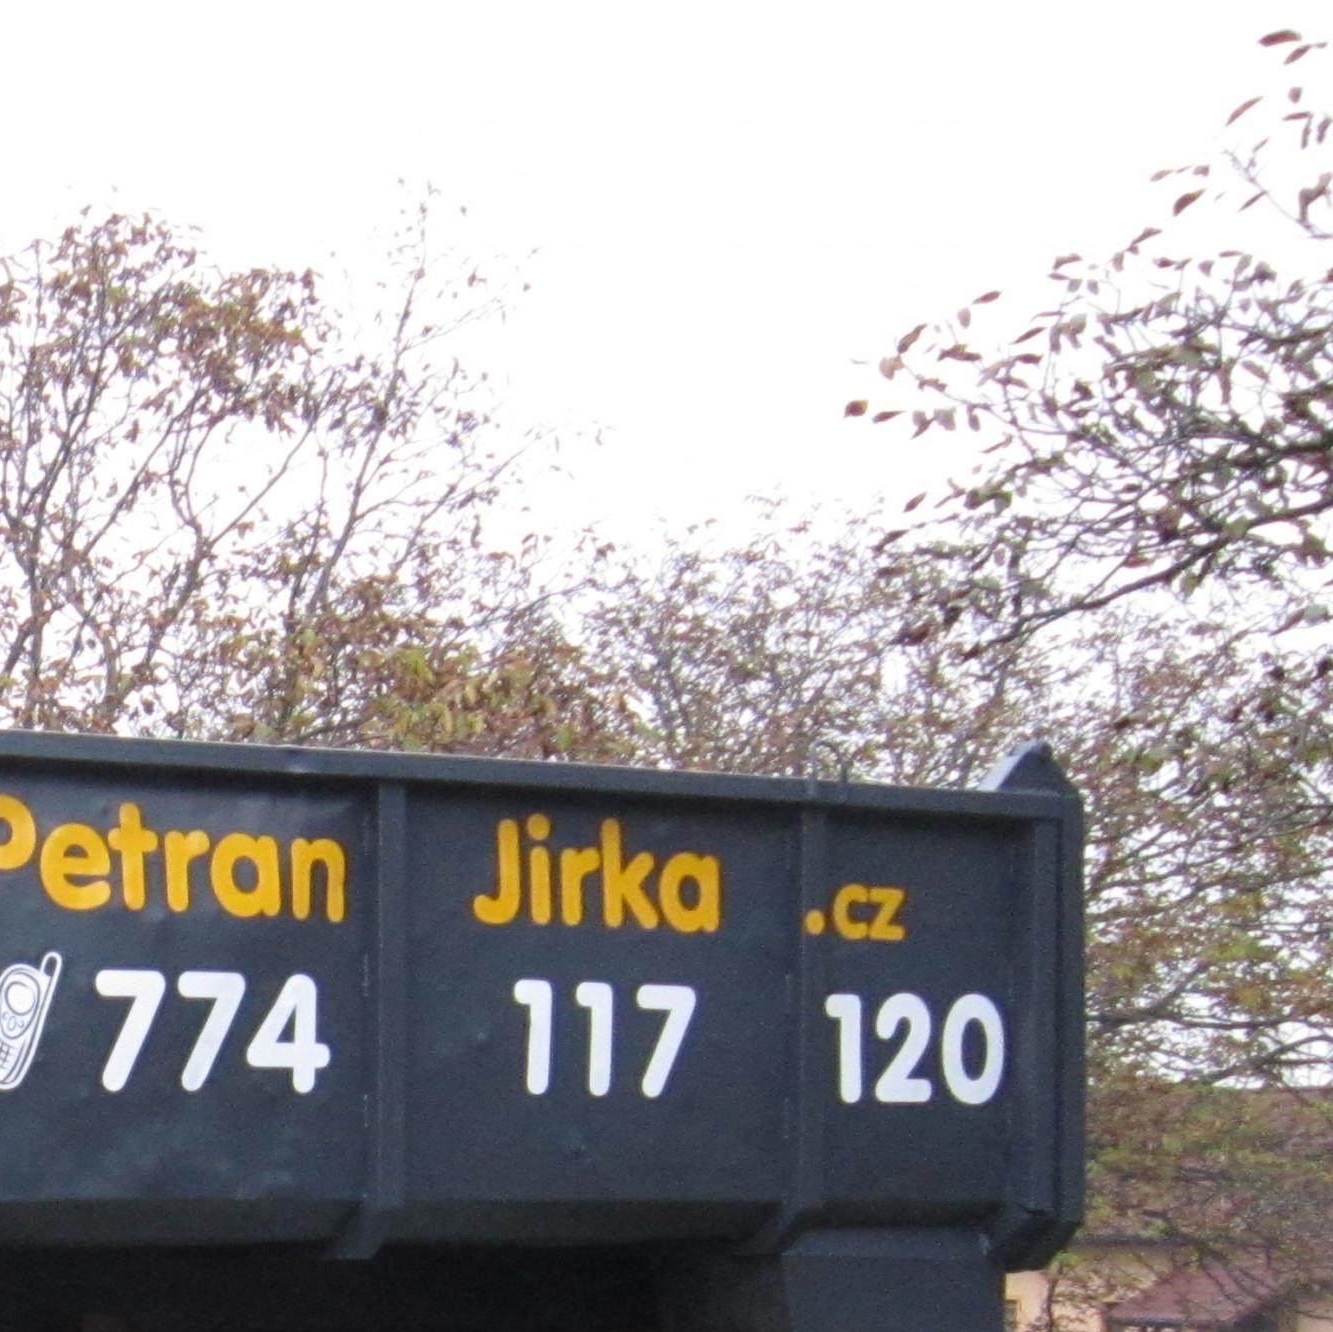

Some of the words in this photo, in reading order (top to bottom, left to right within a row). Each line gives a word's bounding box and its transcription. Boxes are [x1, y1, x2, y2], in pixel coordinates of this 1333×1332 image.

[472, 813, 721, 934] Jirka
[803, 884, 906, 942] .cz
[95, 969, 330, 1094] 774
[513, 978, 697, 1098] 117
[825, 992, 1005, 1105] 120
